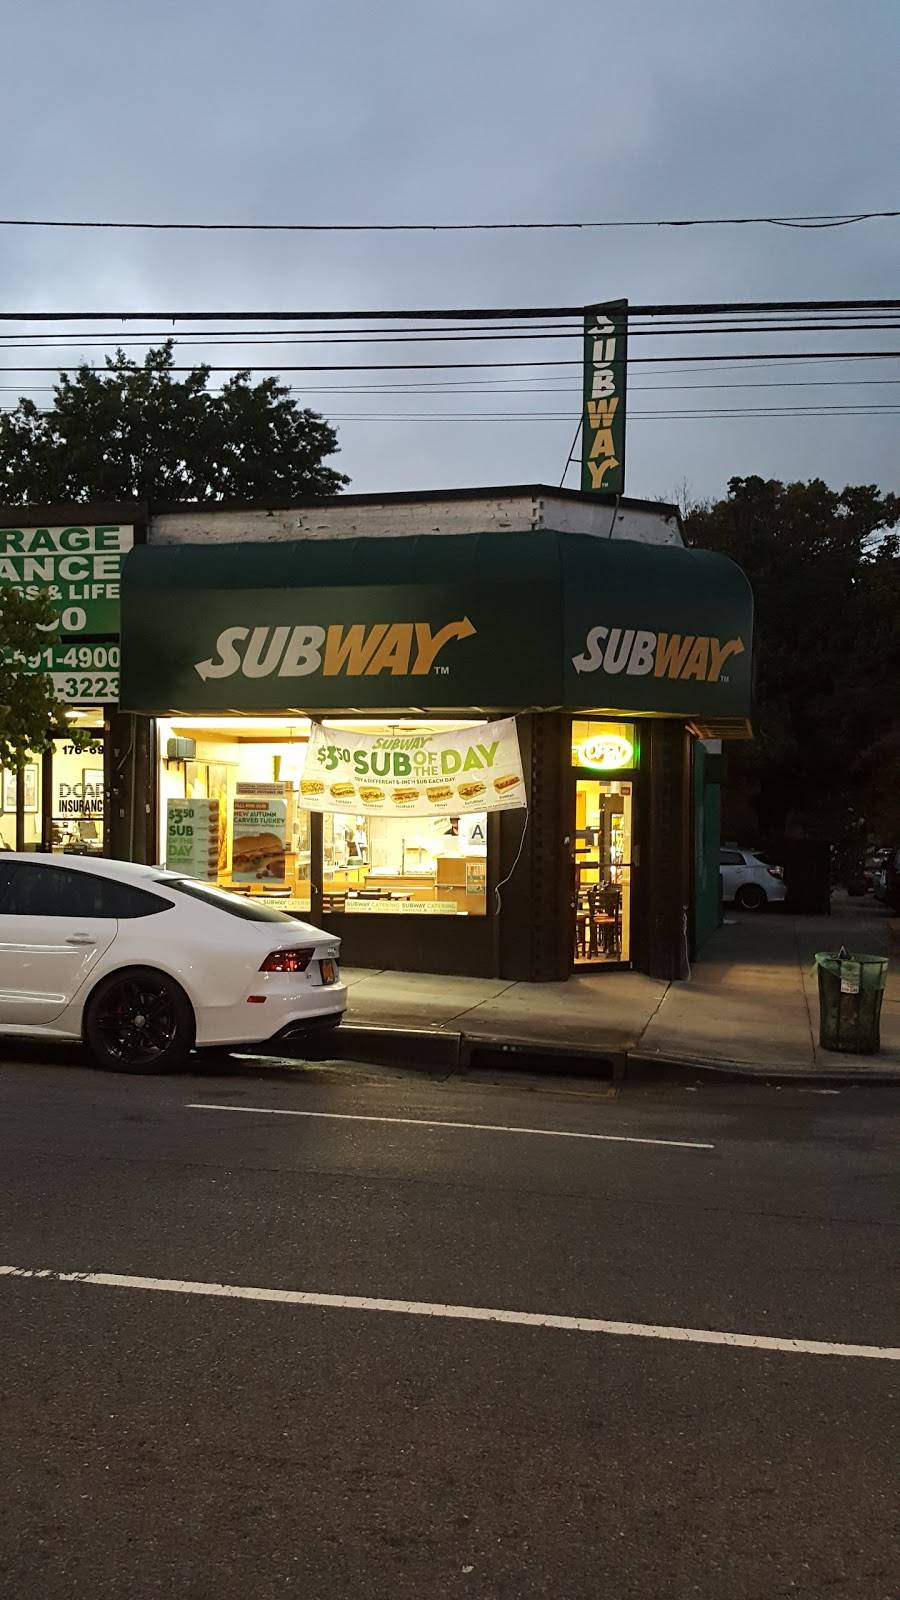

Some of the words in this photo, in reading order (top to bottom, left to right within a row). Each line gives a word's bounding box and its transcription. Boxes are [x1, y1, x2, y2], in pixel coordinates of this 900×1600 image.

[587, 315, 620, 489] SUBWAY
[0, 528, 120, 553] RAGE
[0, 556, 120, 581] ANCE
[48, 585, 62, 600] &
[69, 584, 120, 600] LIFE
[194, 616, 477, 681] SUBWAY
[571, 626, 745, 682] SUBWAY
[434, 666, 450, 675] TM
[371, 737, 433, 750] SUBWAY
[352, 750, 412, 777] SUB
[413, 751, 437, 765] OF
[440, 741, 499, 774] DAY
[413, 766, 438, 776] THE
[168, 825, 194, 836] SUB
[471, 824, 484, 839] A
[168, 845, 193, 856] DAY
